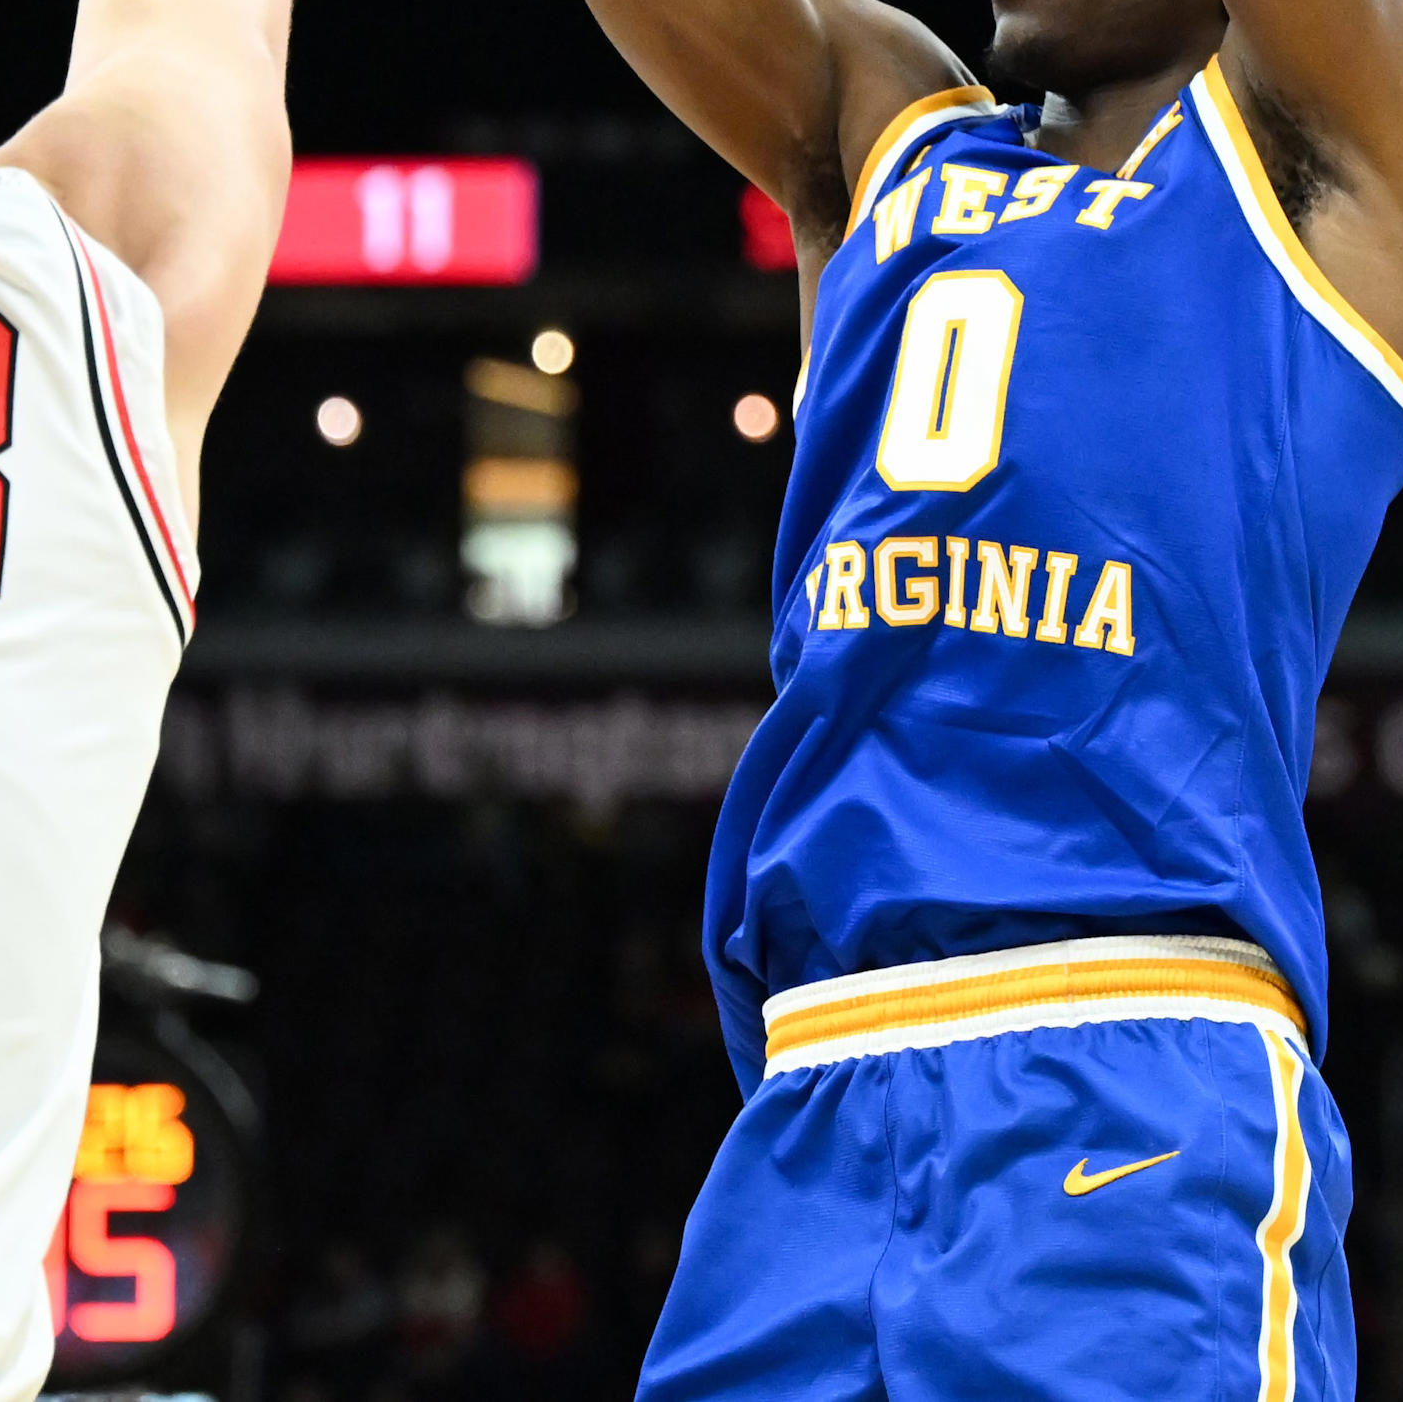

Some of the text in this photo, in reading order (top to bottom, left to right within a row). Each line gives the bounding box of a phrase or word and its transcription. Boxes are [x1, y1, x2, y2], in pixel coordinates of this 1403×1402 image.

[356, 166, 456, 270] 11
[872, 162, 1155, 265] WEST
[875, 269, 1024, 492] 0
